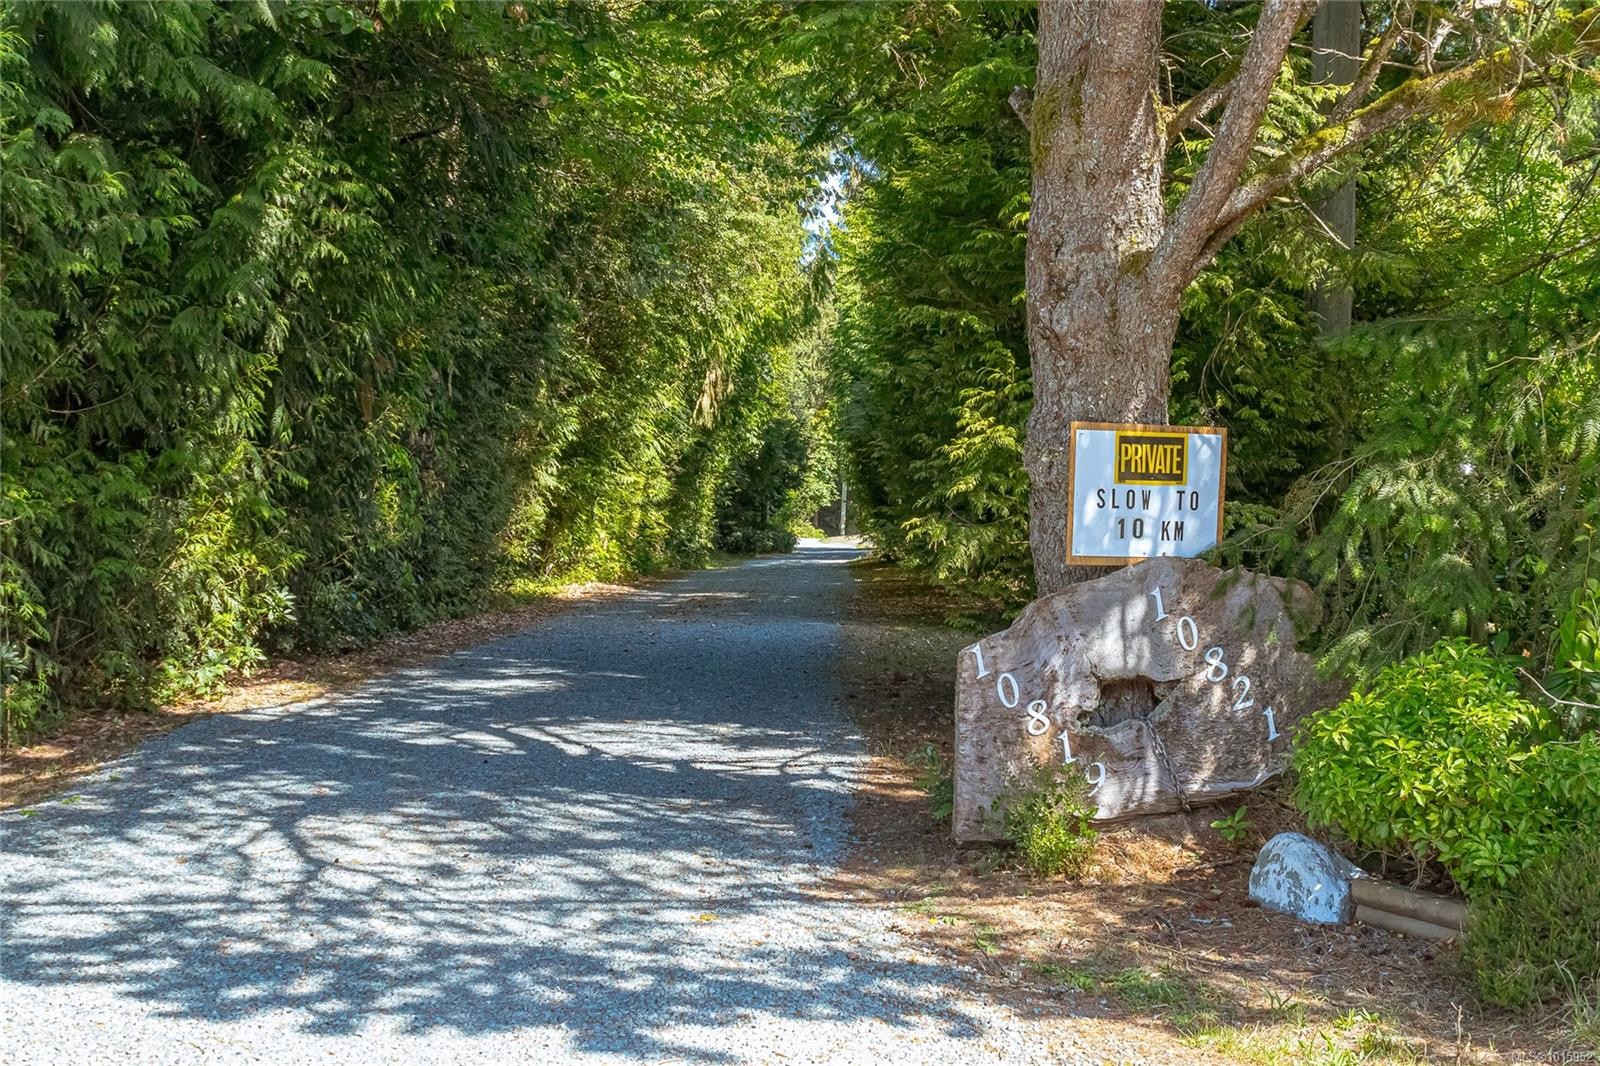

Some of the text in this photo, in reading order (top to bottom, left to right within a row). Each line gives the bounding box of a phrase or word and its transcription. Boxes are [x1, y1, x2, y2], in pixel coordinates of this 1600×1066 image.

[1121, 444, 1183, 474] PRIVATE
[1096, 488, 1199, 511] SLOW TO
[1117, 518, 1184, 541] 10 KM
[1150, 586, 1280, 742] 10821
[970, 642, 1106, 797] 10819
